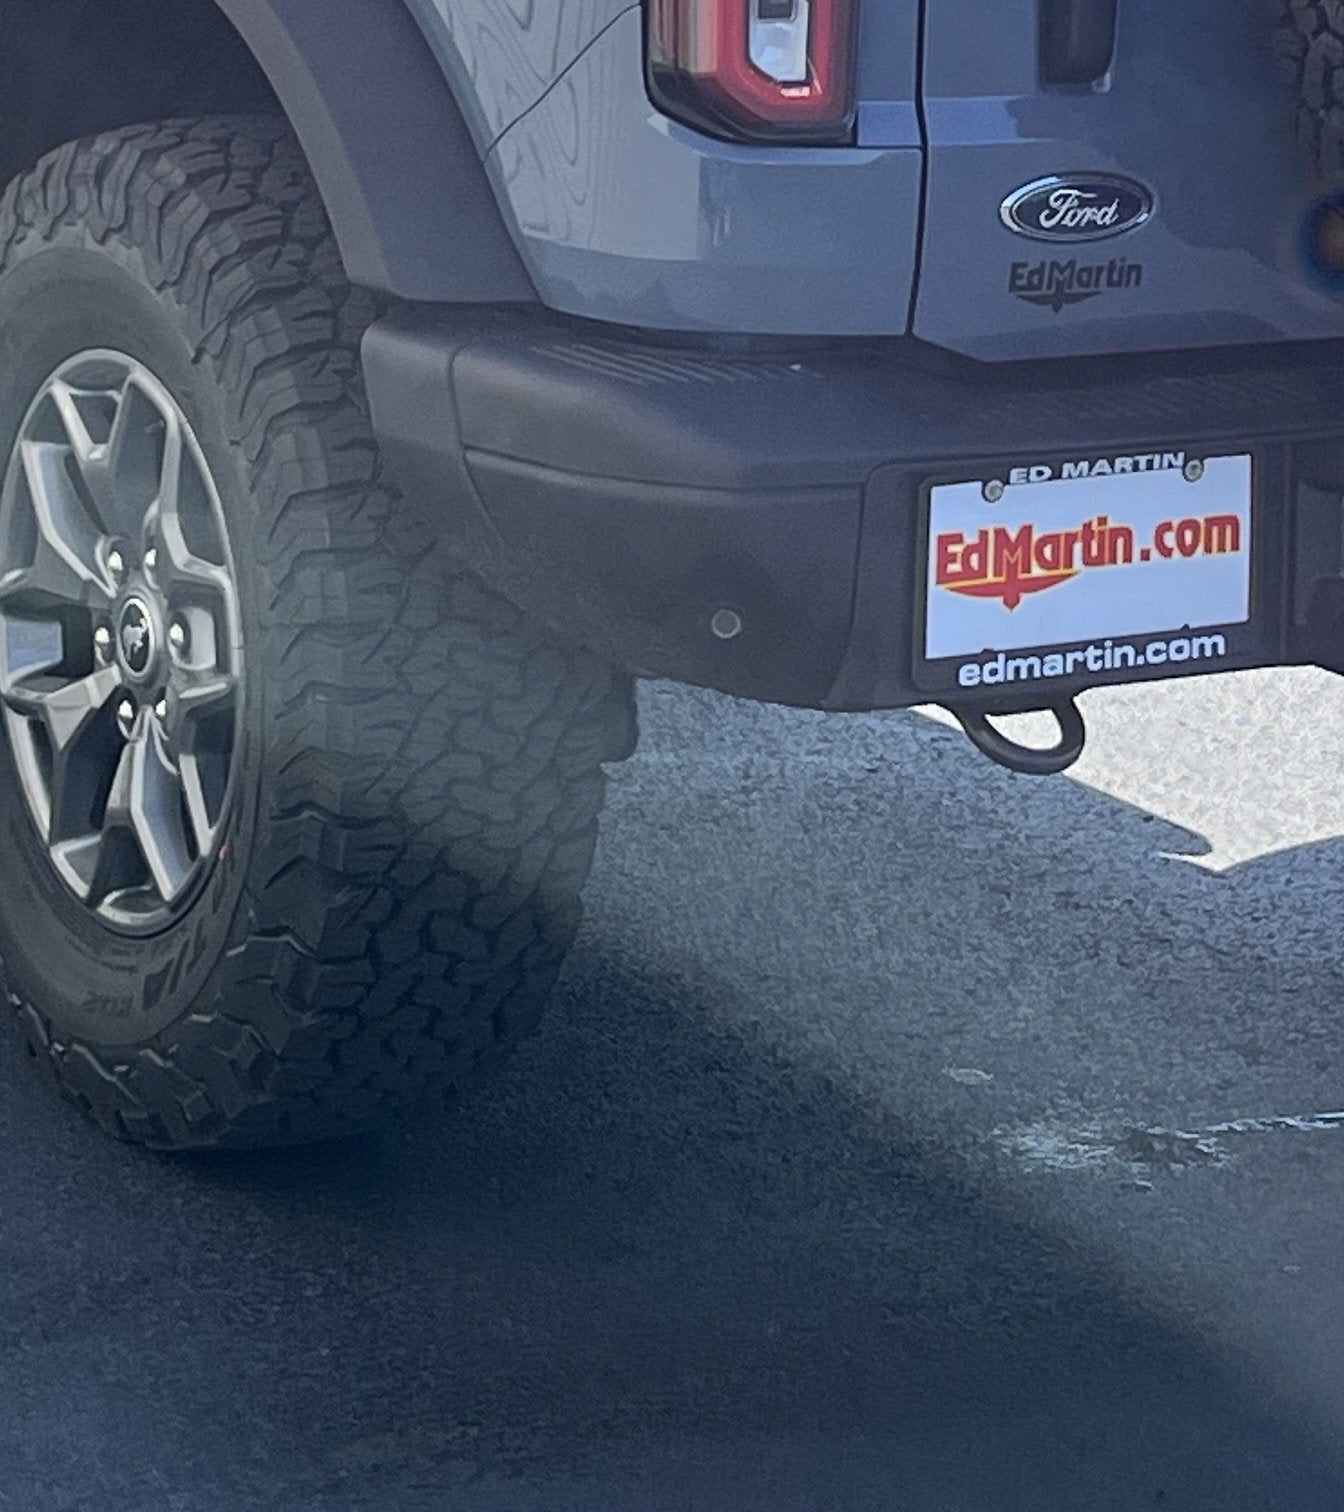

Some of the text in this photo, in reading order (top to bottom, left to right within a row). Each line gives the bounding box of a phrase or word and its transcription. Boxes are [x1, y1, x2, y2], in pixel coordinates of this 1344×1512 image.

[1039, 189, 1121, 228] Ford
[1008, 452, 1186, 486] ED MARTIN
[958, 631, 1227, 688] edmartin.com
